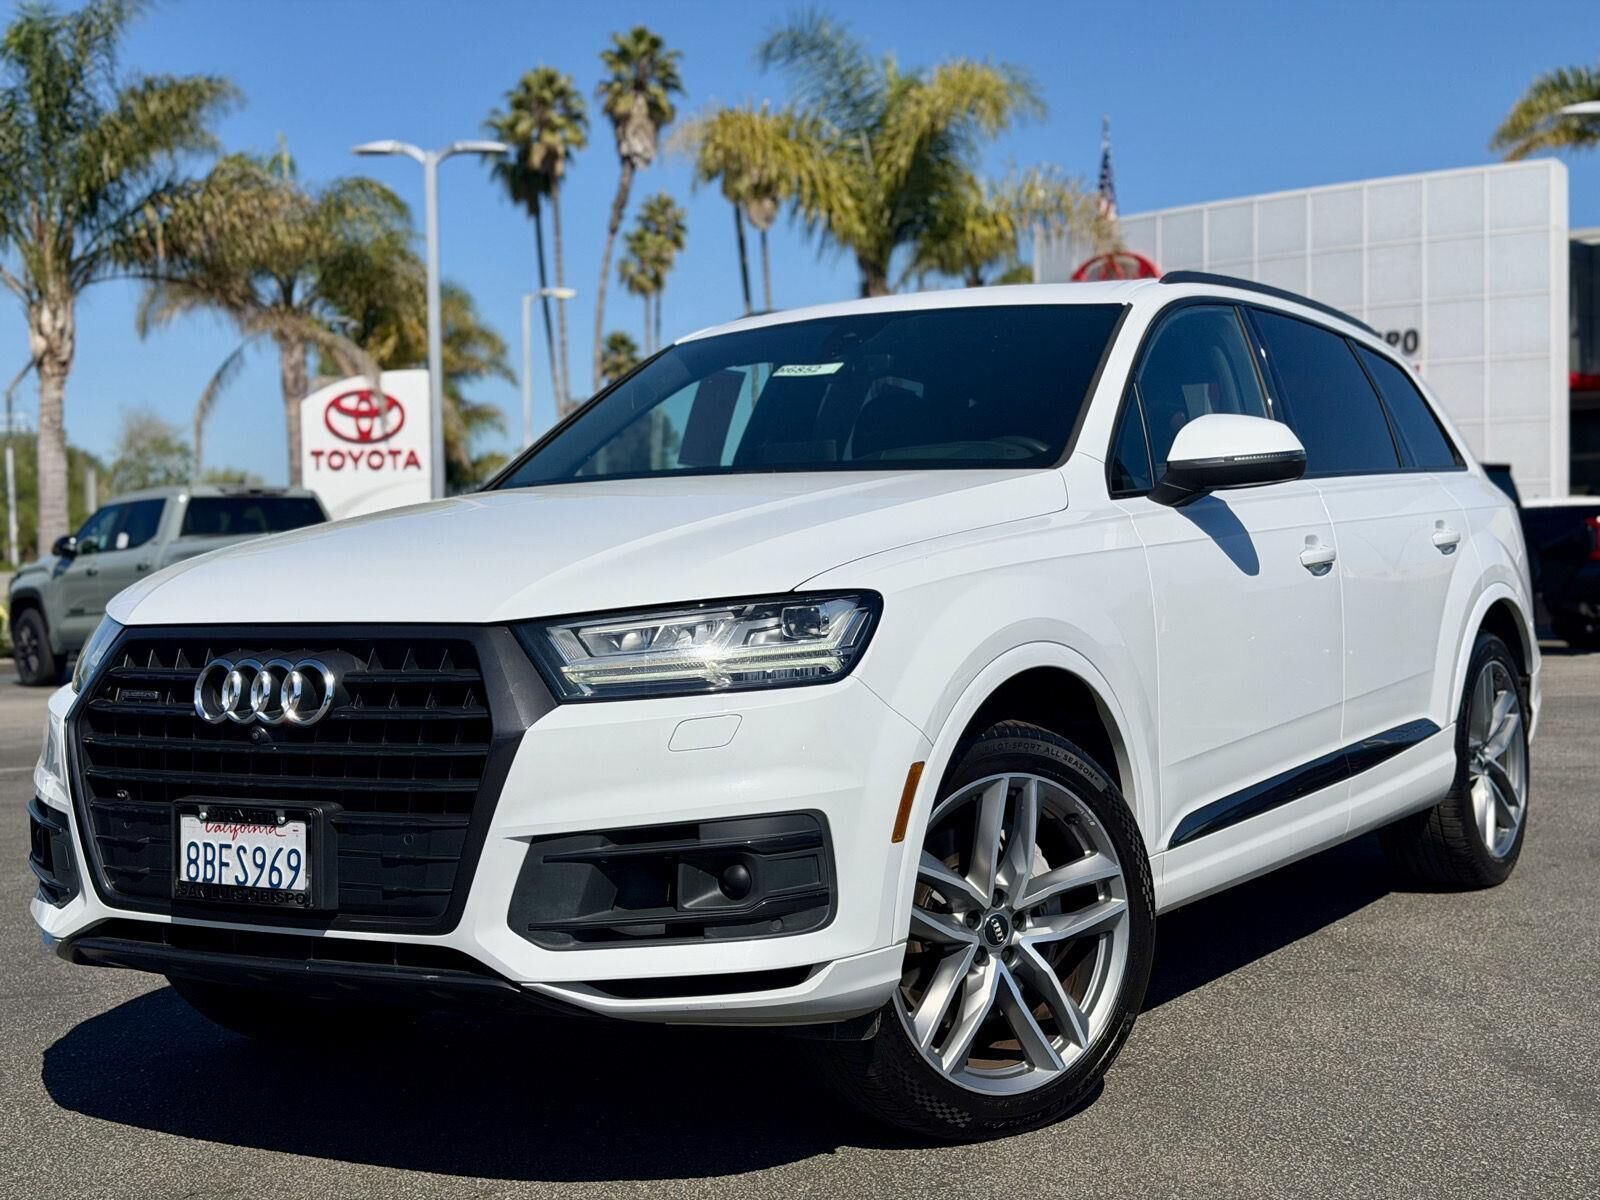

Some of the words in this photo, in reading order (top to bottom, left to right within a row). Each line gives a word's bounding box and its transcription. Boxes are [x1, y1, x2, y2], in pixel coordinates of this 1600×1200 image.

[310, 450, 422, 471] TOYOTA
[1011, 742, 1041, 752] SPORT
[1045, 747, 1061, 758] ALL
[1063, 754, 1095, 779] SEASON
[186, 841, 302, 890] 8BFS969
